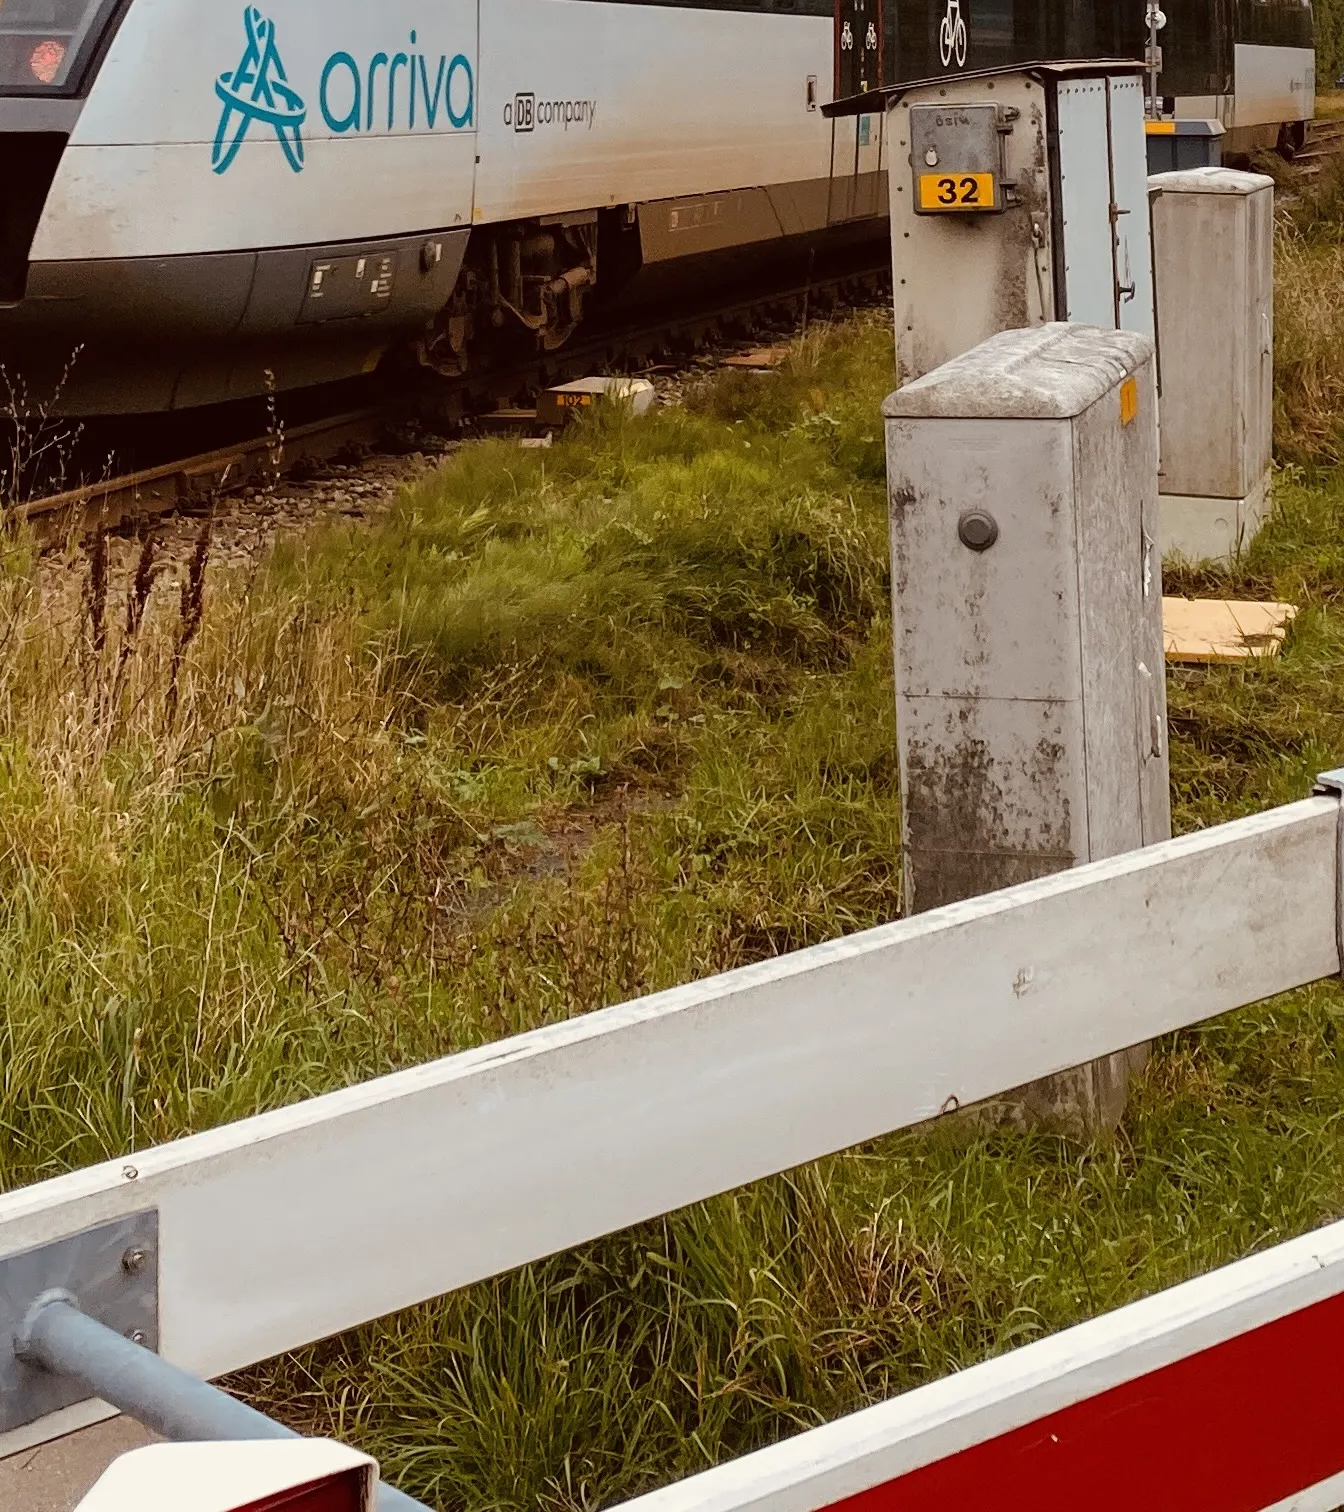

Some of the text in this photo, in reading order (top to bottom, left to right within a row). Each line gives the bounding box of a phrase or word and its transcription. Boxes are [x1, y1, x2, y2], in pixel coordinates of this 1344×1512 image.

[319, 29, 474, 133] arriva
[503, 98, 596, 131] a DB company
[937, 177, 979, 204] 32
